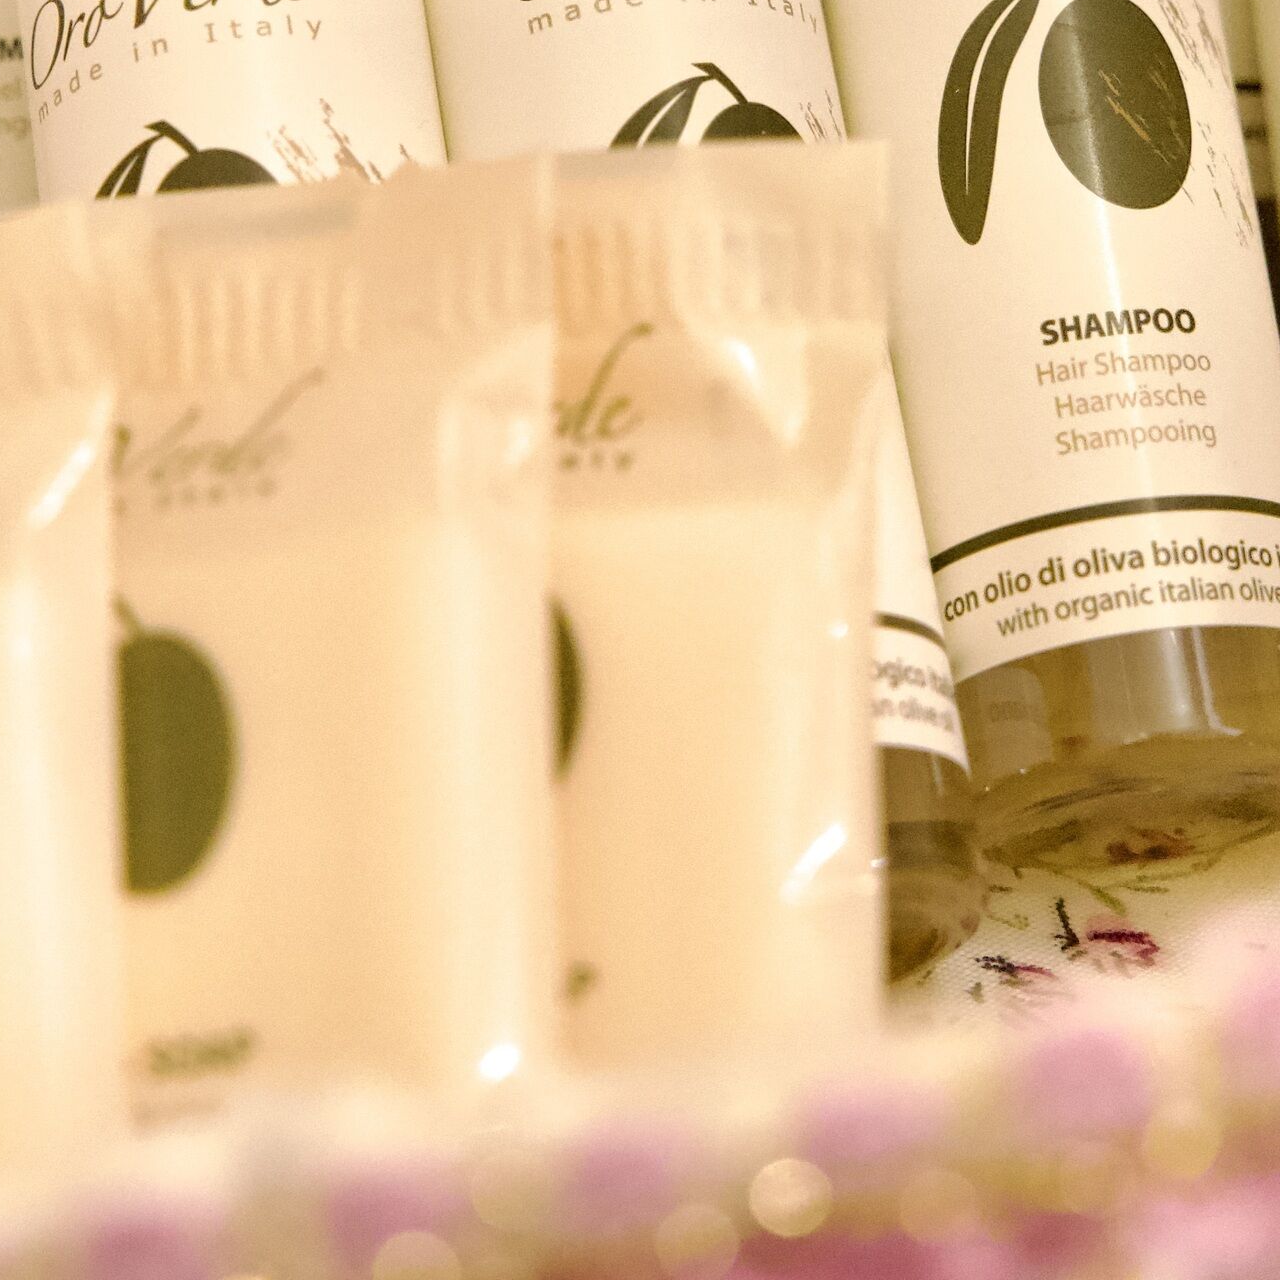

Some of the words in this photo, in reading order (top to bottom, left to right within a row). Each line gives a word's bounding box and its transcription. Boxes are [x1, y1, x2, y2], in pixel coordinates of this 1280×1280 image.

[37, 63, 104, 124] made
[132, 37, 169, 63] in
[204, 13, 322, 44] Italy
[1039, 307, 1197, 346] SHAMPOO
[1035, 355, 1088, 387] Hair
[1093, 350, 1211, 379] Shampoo
[1053, 382, 1208, 419] Haarwäsche
[1055, 420, 1218, 456] Shampooing
[944, 589, 980, 622] con
[983, 570, 1032, 604] olio
[1038, 556, 1066, 587] di
[1072, 546, 1145, 579] oliva
[1150, 537, 1272, 570] biologico
[996, 600, 1050, 637] with
[1055, 582, 1154, 621] organic
[1157, 576, 1235, 604] italian
